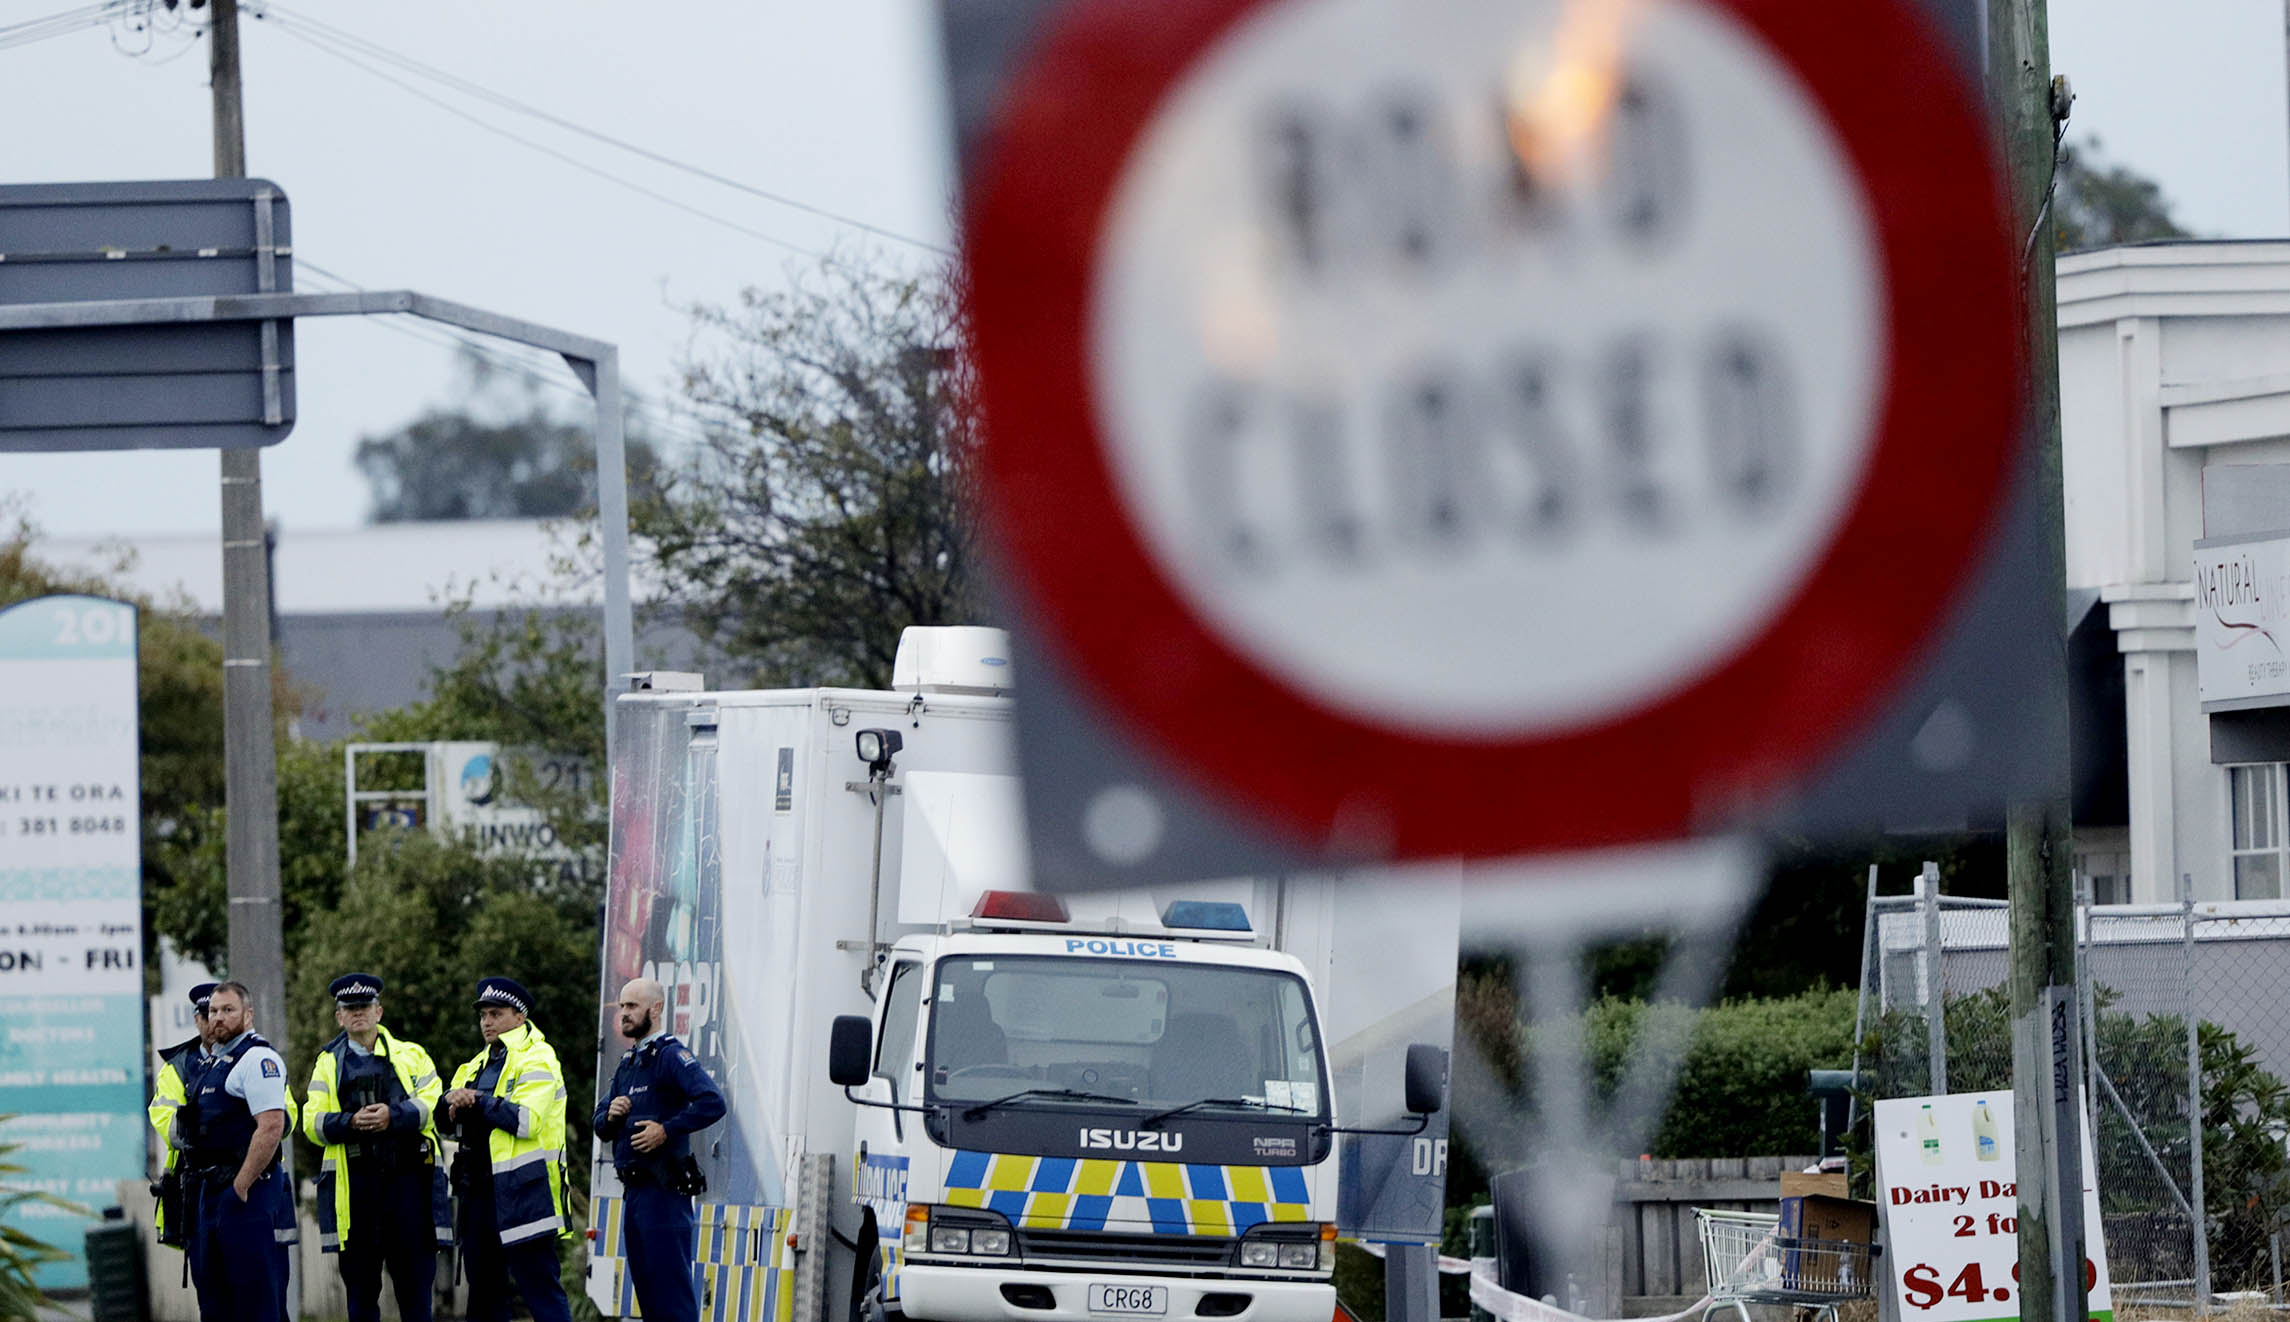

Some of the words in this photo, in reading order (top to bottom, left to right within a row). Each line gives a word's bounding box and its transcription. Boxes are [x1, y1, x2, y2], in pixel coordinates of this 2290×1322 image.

[1185, 324, 1802, 578] CLOSED
[2199, 560, 2259, 609] NATURAL
[53, 608, 133, 643] 201
[33, 784, 56, 800] TE
[70, 784, 123, 800] ORA
[21, 818, 56, 833] 381
[86, 949, 133, 969] FRI
[1065, 939, 1177, 958] POLICE
[641, 960, 720, 1058] TOP!
[1080, 1128, 1183, 1152] ISUZU
[1254, 1148, 1296, 1157] TURBO
[1891, 1183, 1971, 1206] Dairy
[1979, 1180, 2017, 1199] Da
[1953, 1215, 1977, 1237] 2
[1986, 1213, 2018, 1235] fo
[1103, 1288, 1152, 1309] CRG8
